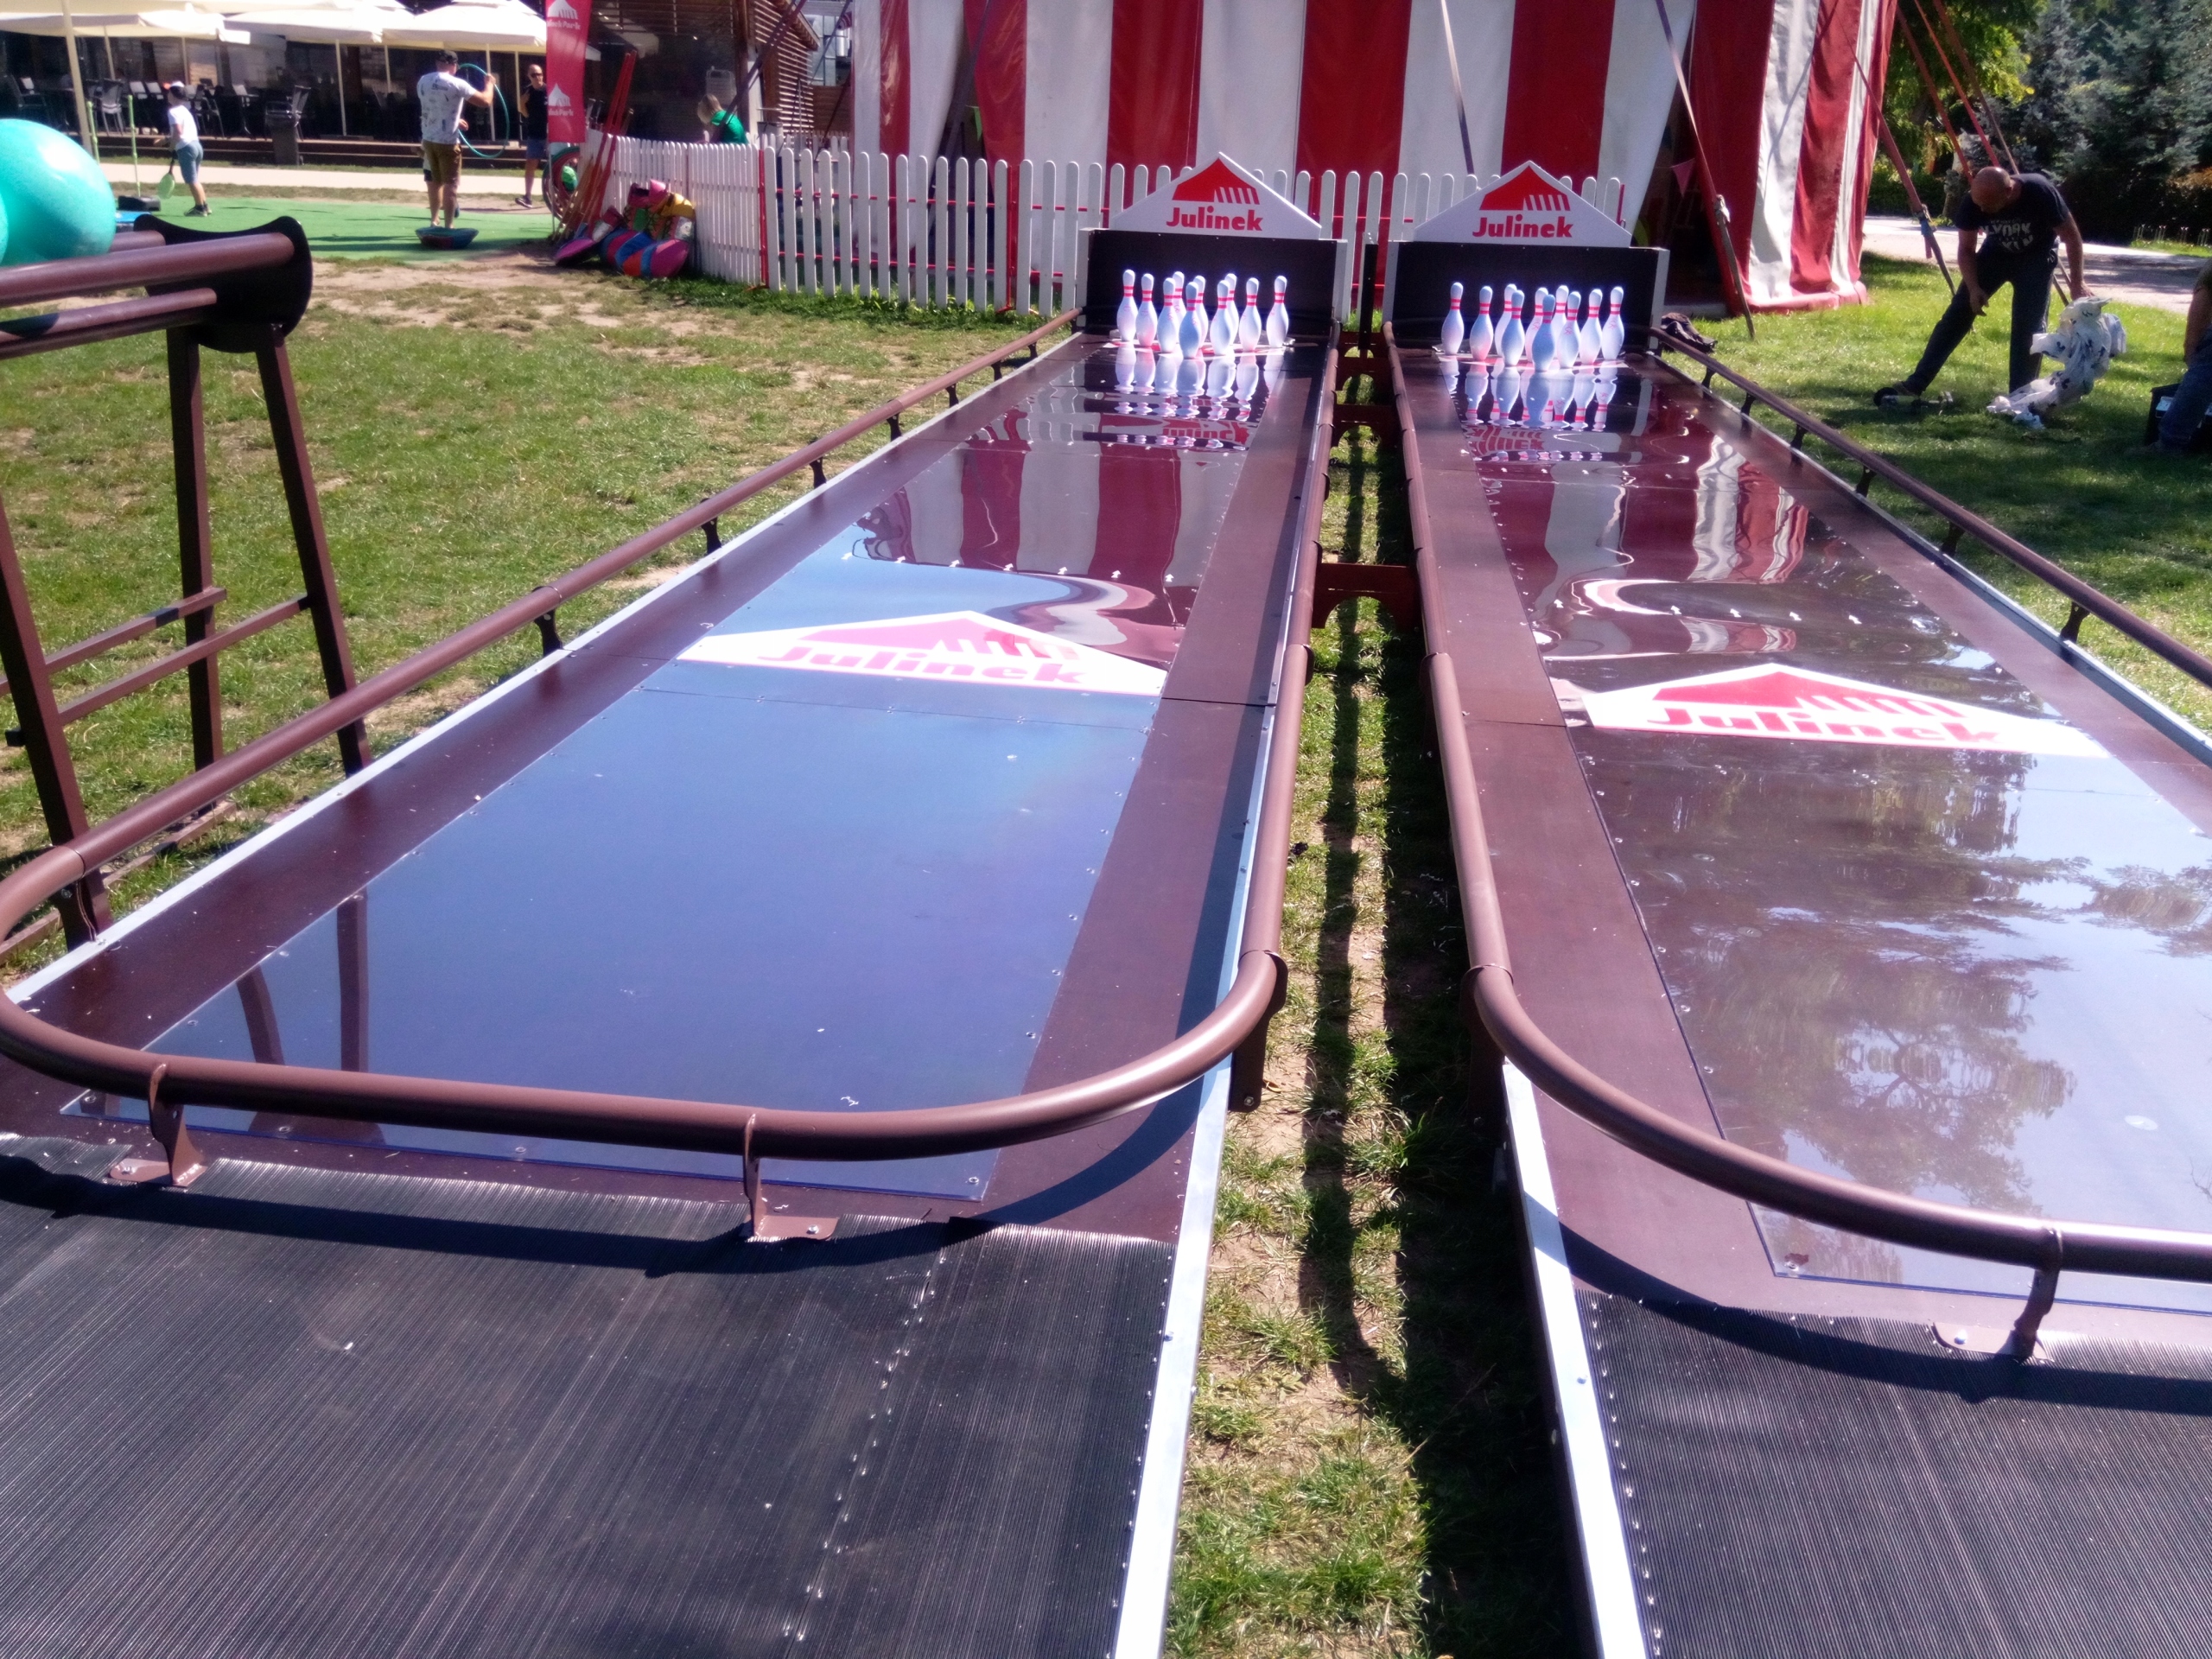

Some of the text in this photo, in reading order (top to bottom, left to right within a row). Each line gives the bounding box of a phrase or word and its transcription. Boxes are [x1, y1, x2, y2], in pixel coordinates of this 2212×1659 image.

[1166, 205, 1264, 232] Julinek
[1471, 213, 1573, 238] Julinek
[757, 645, 1087, 684] Julinek
[1647, 707, 1999, 743] Julinek
